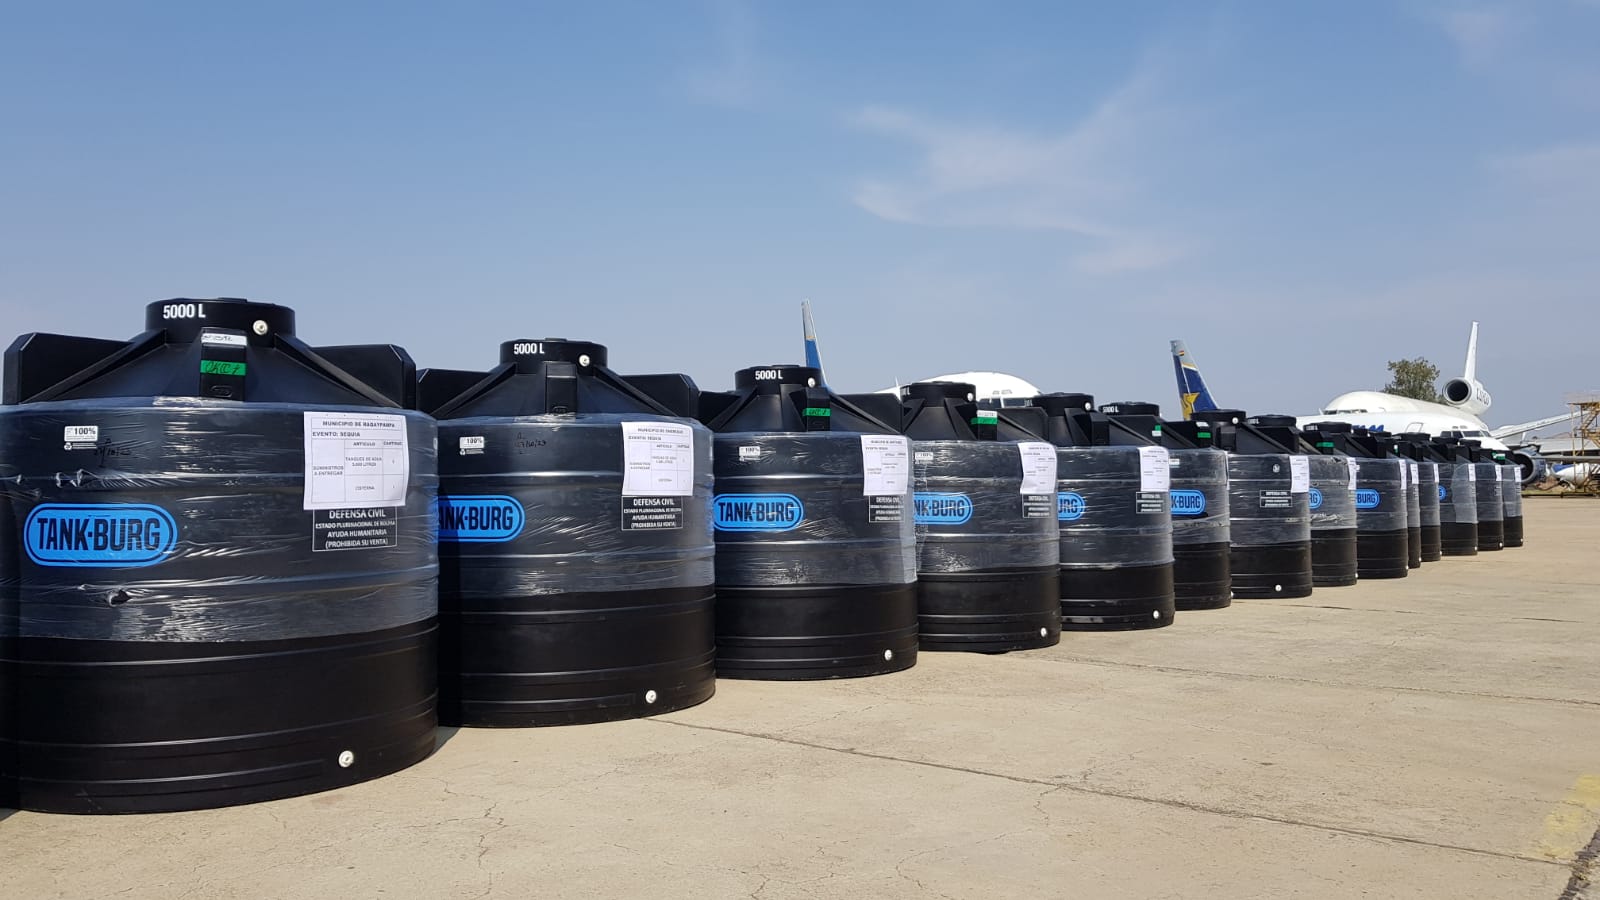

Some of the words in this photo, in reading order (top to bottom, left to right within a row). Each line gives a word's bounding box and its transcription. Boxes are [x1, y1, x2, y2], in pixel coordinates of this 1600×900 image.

[163, 304, 195, 319] 5000
[198, 303, 206, 318] L
[514, 343, 537, 355] 5000
[539, 343, 545, 354] L
[755, 370, 776, 380] 5000
[778, 370, 783, 379] L
[74, 427, 96, 435] 100%
[914, 500, 965, 516] NK-BURG
[1171, 496, 1200, 508] K-BURG
[329, 510, 366, 519] DEFENSA
[368, 508, 386, 518] CIVIL
[438, 506, 513, 530] ANK-BURG
[325, 540, 360, 549] (PROHIBIDA
